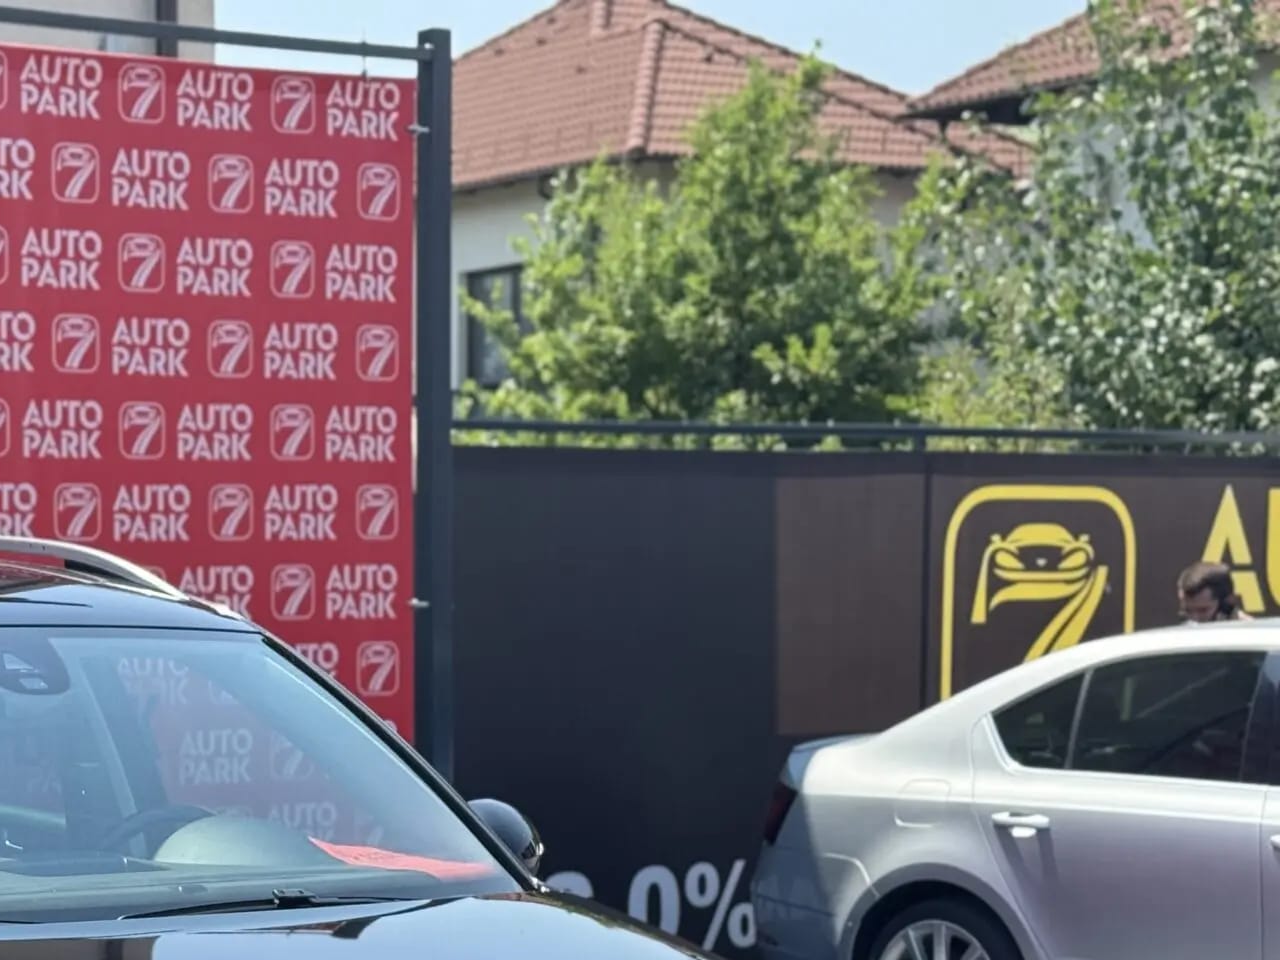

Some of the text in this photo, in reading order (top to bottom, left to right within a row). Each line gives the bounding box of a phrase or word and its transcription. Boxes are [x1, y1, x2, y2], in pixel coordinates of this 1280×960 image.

[20, 57, 102, 89] AUTO
[176, 70, 253, 102] AUTO
[20, 83, 100, 120] PARK
[326, 82, 401, 111] AUTO
[177, 97, 252, 132] PARK
[327, 108, 399, 142] PARK
[111, 148, 191, 181] AUTO
[265, 158, 340, 189] AUTO
[111, 177, 189, 211] PARK
[265, 186, 337, 218] PARK
[21, 228, 103, 260] AUTO
[176, 237, 254, 268] AUTO
[326, 243, 398, 274] AUTO
[21, 257, 100, 291] PARK
[176, 265, 251, 297] PARK
[325, 271, 396, 303] PARK
[112, 317, 191, 348] AUTO
[264, 322, 339, 352] AUTO
[112, 346, 188, 377] PARK
[264, 350, 336, 380] PARK
[22, 399, 103, 429] AUTO
[177, 403, 254, 432] AUTO
[325, 405, 398, 434] AUTO
[22, 428, 102, 459] PARK
[177, 431, 252, 461] PARK
[325, 433, 395, 462] PARK
[113, 484, 191, 513] AUTO
[264, 483, 339, 512] AUTO
[111, 514, 190, 542] PARK
[265, 512, 337, 540] PARK
[181, 565, 256, 598] AUTO
[326, 563, 398, 592] AUTO
[326, 591, 396, 619] PARK
